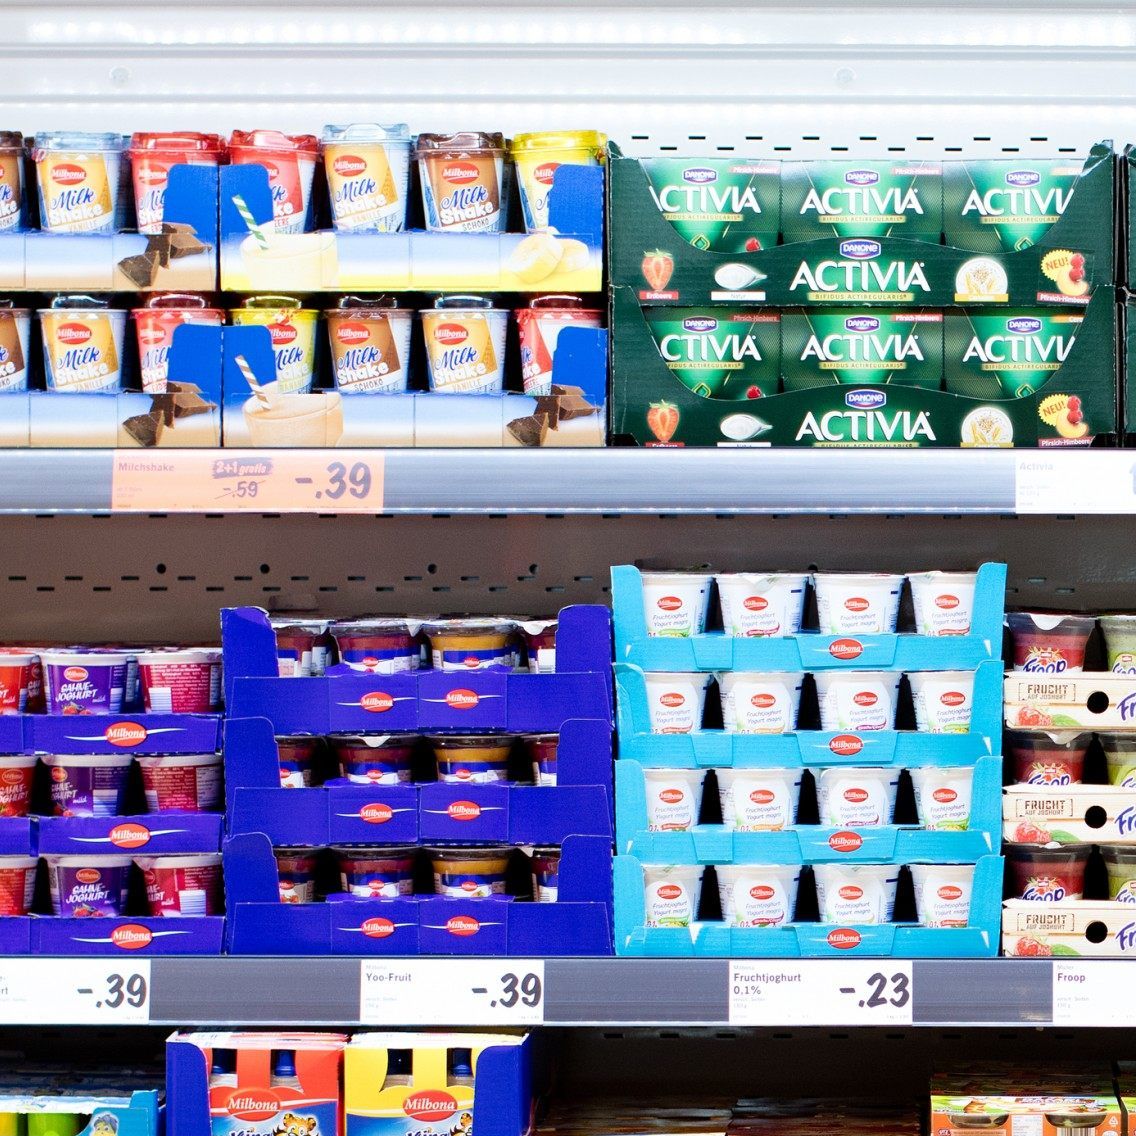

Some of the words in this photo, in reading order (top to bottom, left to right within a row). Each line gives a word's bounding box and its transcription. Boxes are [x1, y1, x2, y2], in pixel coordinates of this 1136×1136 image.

[442, 187, 488, 210] Milk
[462, 218, 489, 230] SCHOKO
[842, 242, 879, 254] DANONE
[1044, 256, 1070, 271] NEU!
[789, 260, 931, 292] ACTIVIA
[57, 349, 100, 372] Milk
[796, 411, 936, 441] ACTIVIA
[118, 463, 175, 472] Milchshake
[216, 462, 237, 473] 2+1
[1019, 462, 1053, 470] Activia
[295, 462, 371, 499] -.39
[829, 643, 862, 655] Milbona
[1027, 684, 1068, 695] FRUCHT
[360, 695, 394, 708] Milbona
[446, 693, 479, 706] Milbona
[107, 726, 147, 742] Milbona
[829, 740, 863, 751] Milbona
[365, 972, 412, 983] Yoo-Fruit
[734, 973, 801, 984] Fruchtjoghurt
[1057, 973, 1085, 983] Froop
[77, 974, 147, 1008] -.39
[471, 972, 542, 1008] -.39
[734, 985, 761, 995] 0.1%
[839, 973, 910, 1008] -.23
[227, 1098, 278, 1112] Milbona
[404, 1098, 458, 1112] Milbona
